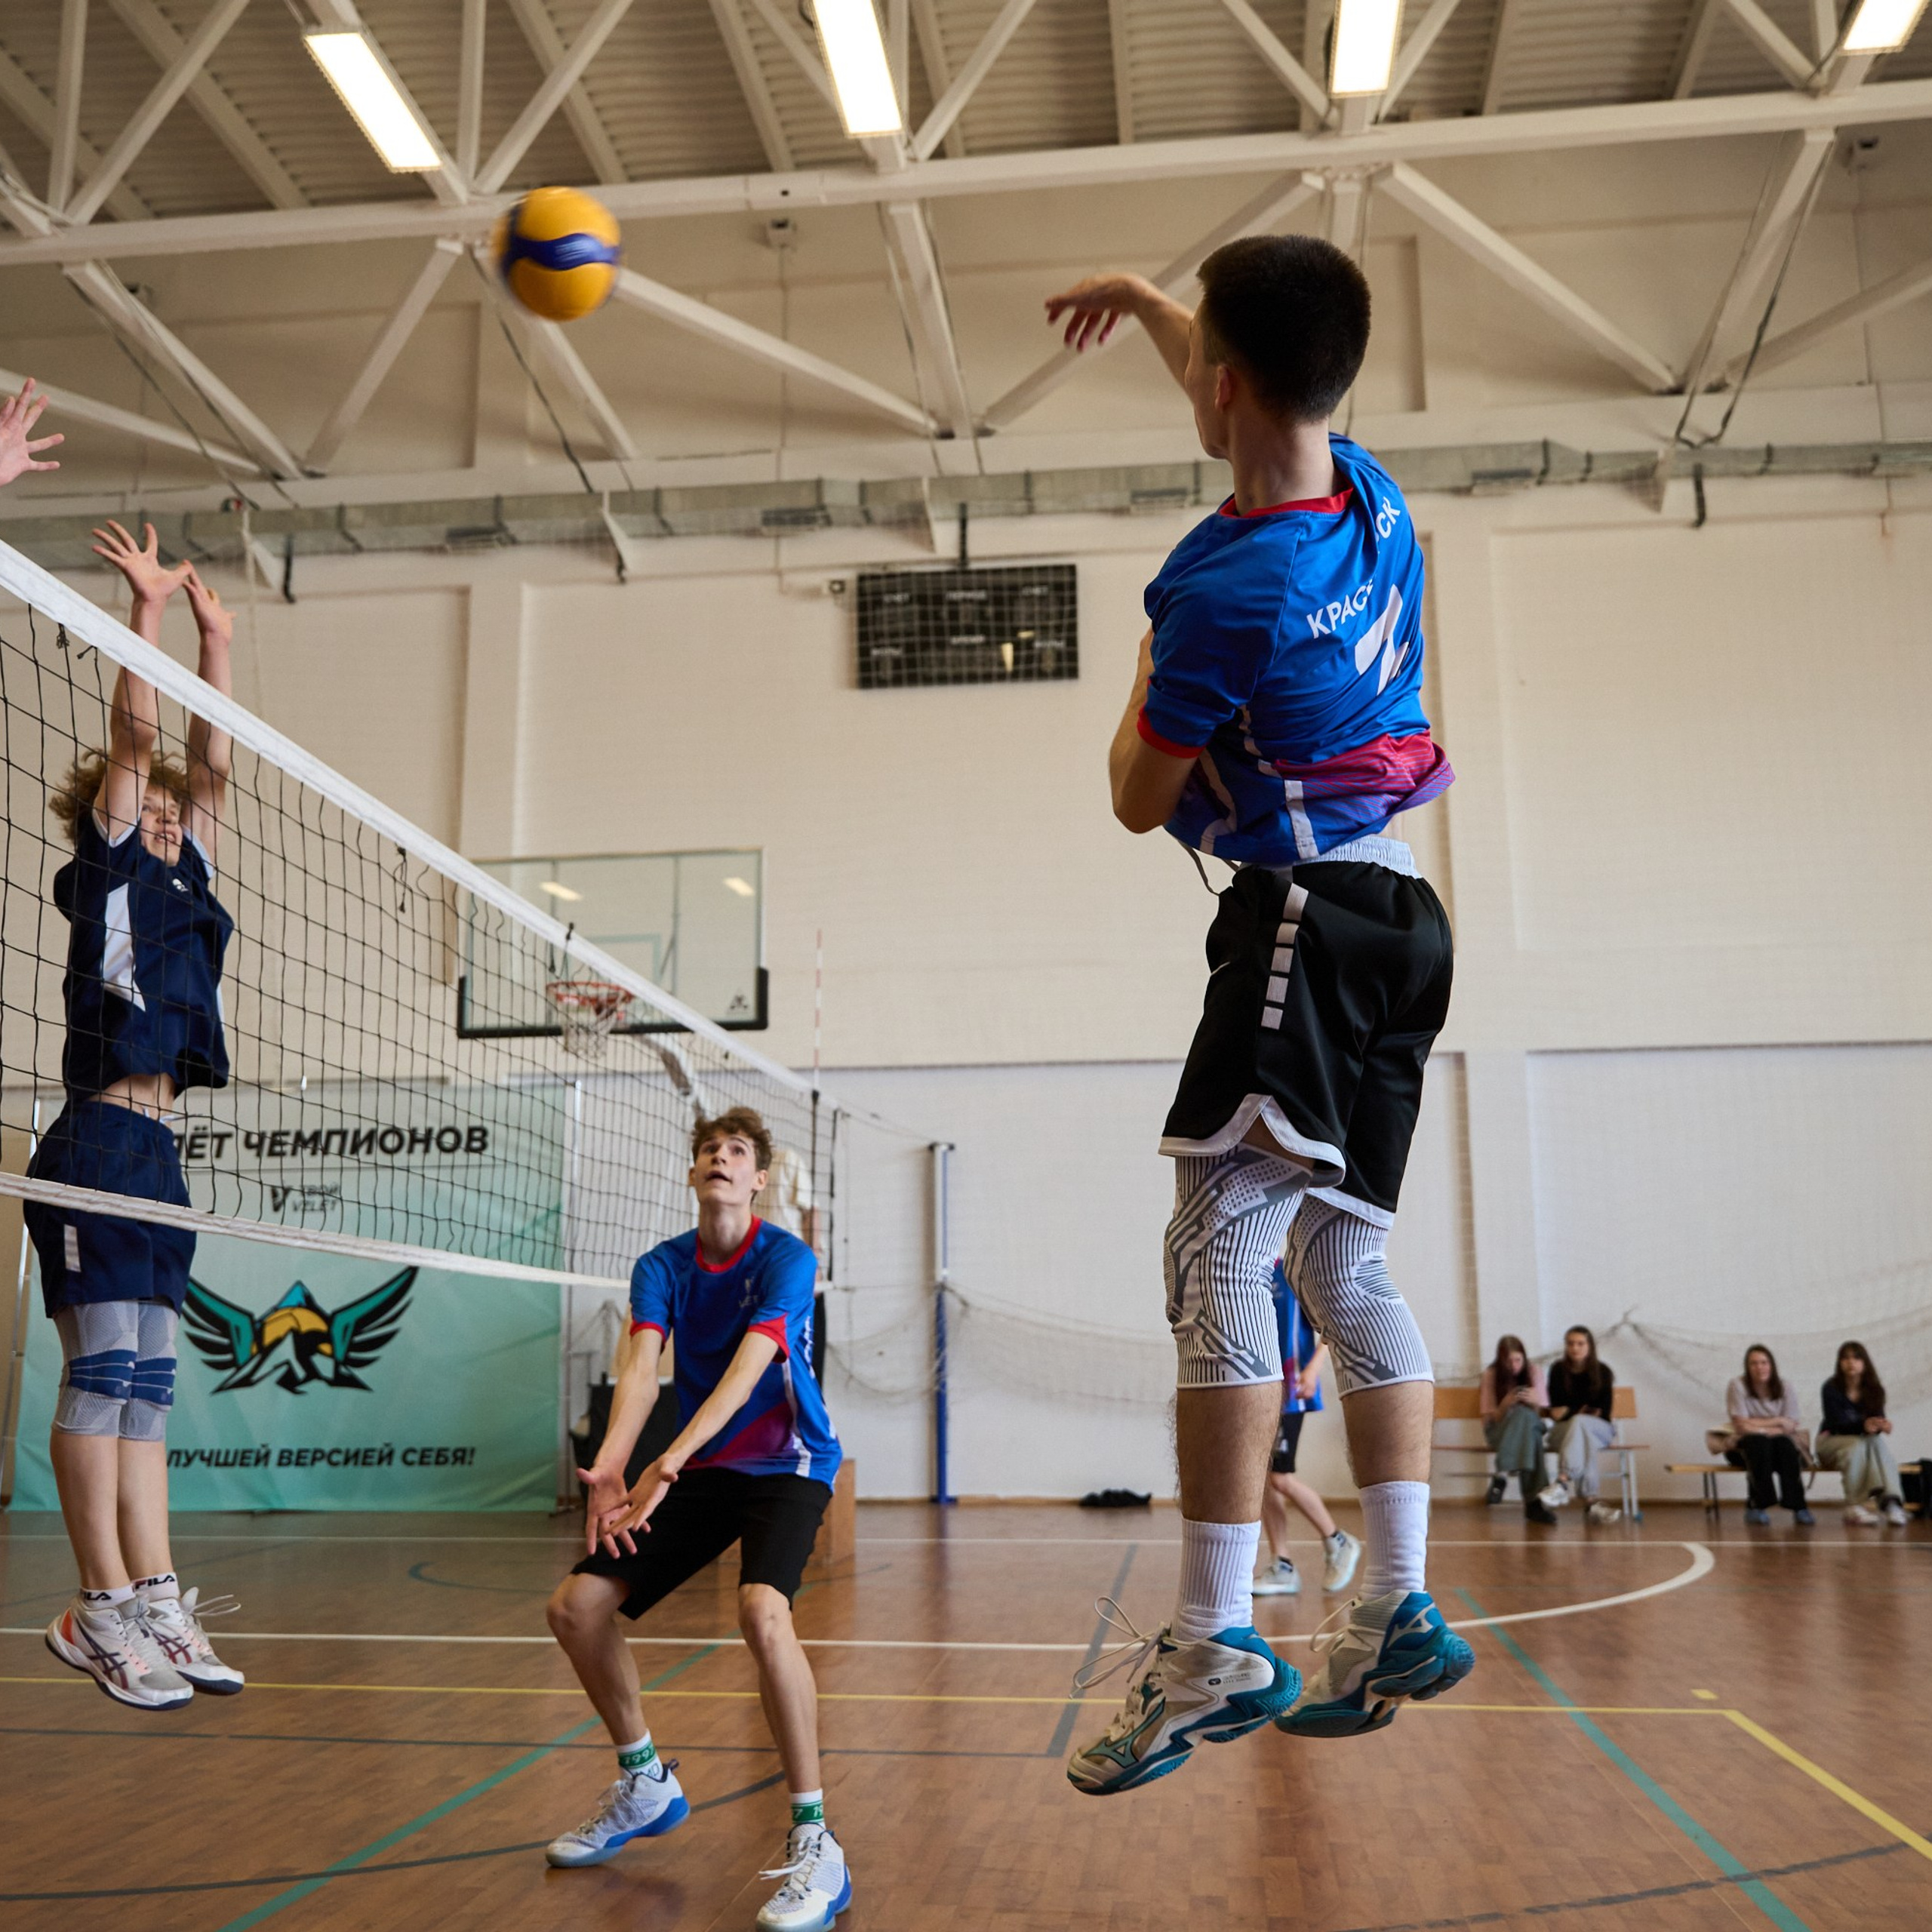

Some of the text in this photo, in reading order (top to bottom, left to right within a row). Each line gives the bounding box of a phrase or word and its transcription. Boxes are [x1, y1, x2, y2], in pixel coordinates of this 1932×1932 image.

[244, 1125, 488, 1158] ЧЕМПИОНОВ
[167, 1442, 476, 1468] ЛУЧШЕЙ ВЕРСИЕЙ СЕБЯ!
[135, 1574, 175, 1589] FILA
[83, 1592, 112, 1601] ILA
